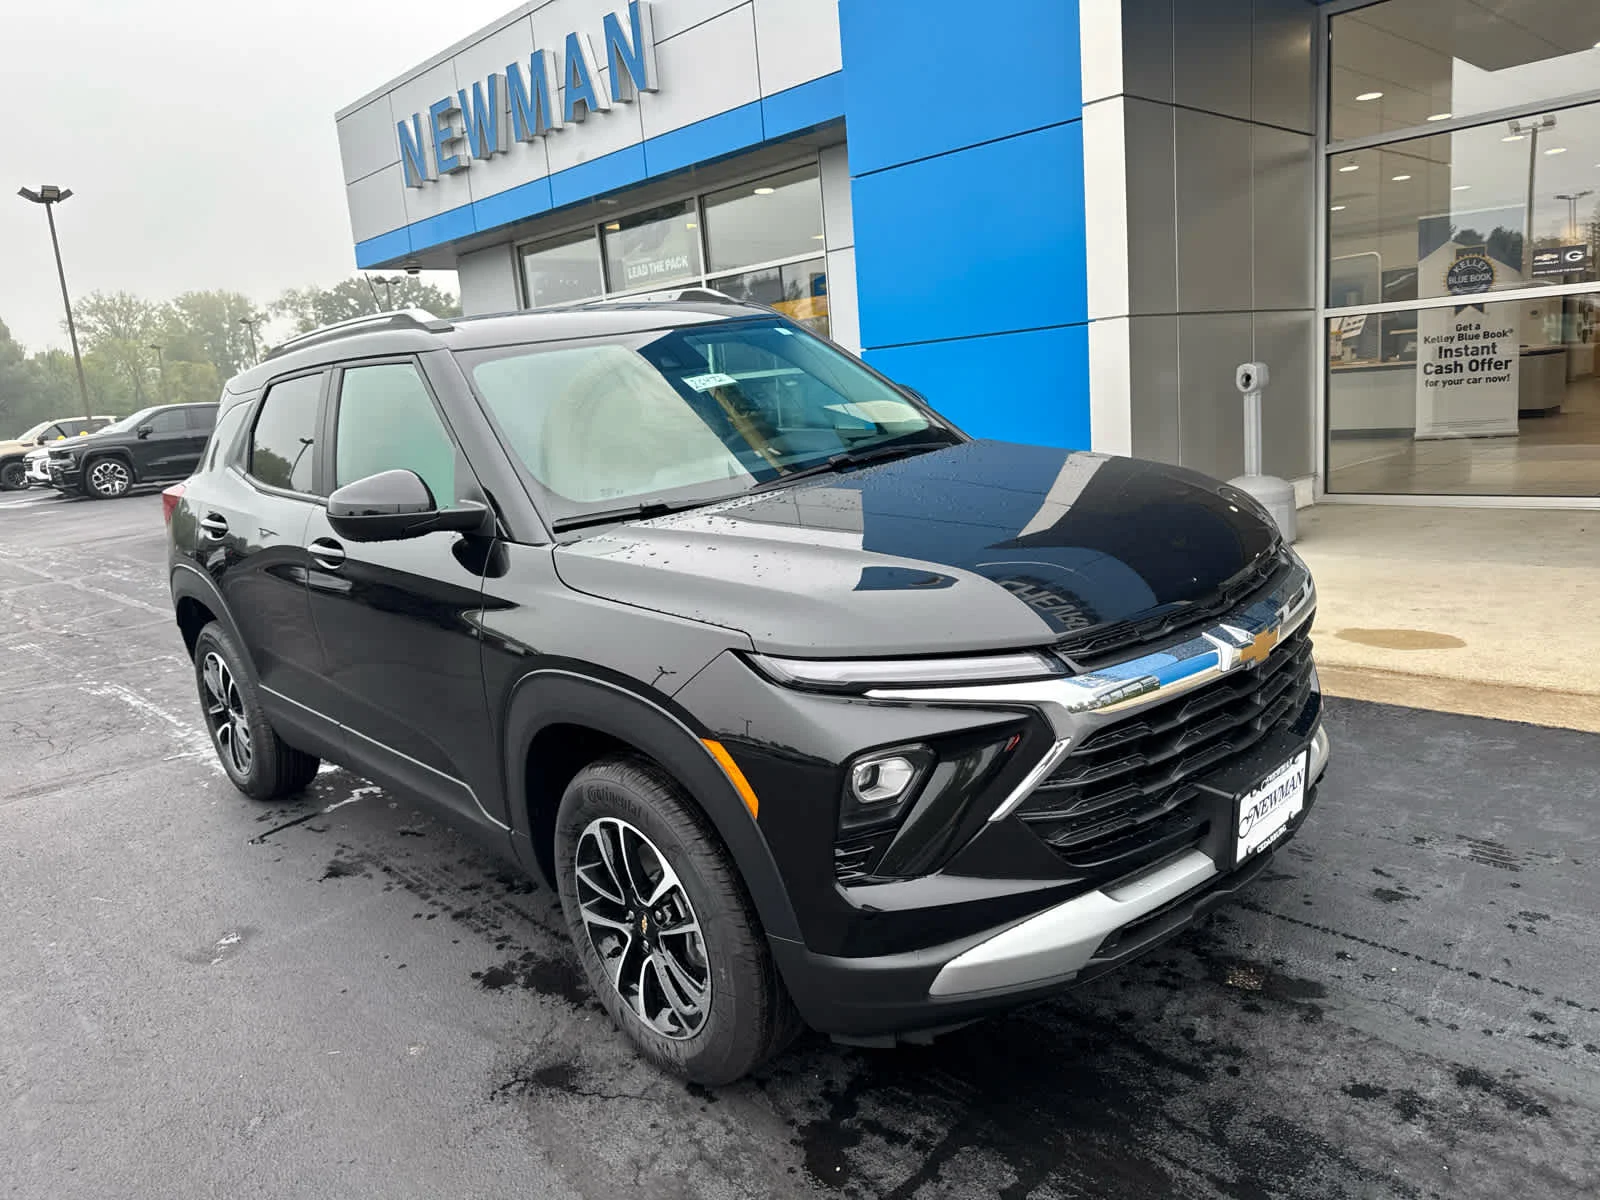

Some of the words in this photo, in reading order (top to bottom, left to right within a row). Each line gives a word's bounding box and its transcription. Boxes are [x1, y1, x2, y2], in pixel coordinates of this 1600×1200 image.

[397, 0, 657, 188] NEWMAN
[628, 264, 648, 280] LEAD
[648, 261, 665, 276] THE
[665, 255, 689, 271] PACK
[1453, 259, 1489, 273] KELLEY
[1448, 275, 1469, 285] BLUE
[1470, 272, 1493, 282] BOOK
[1455, 323, 1473, 332] Get
[1475, 323, 1481, 331] a
[1423, 334, 1455, 344] Kelley
[1457, 332, 1481, 341] Blue
[1438, 342, 1497, 359] Instant
[1423, 360, 1464, 375] Cash
[1468, 357, 1513, 372] Offer
[1425, 378, 1440, 387] for
[1441, 377, 1465, 388] your
[1466, 376, 1483, 385] car
[1485, 373, 1511, 383] now!
[1239, 768, 1304, 839] NEWMAN
